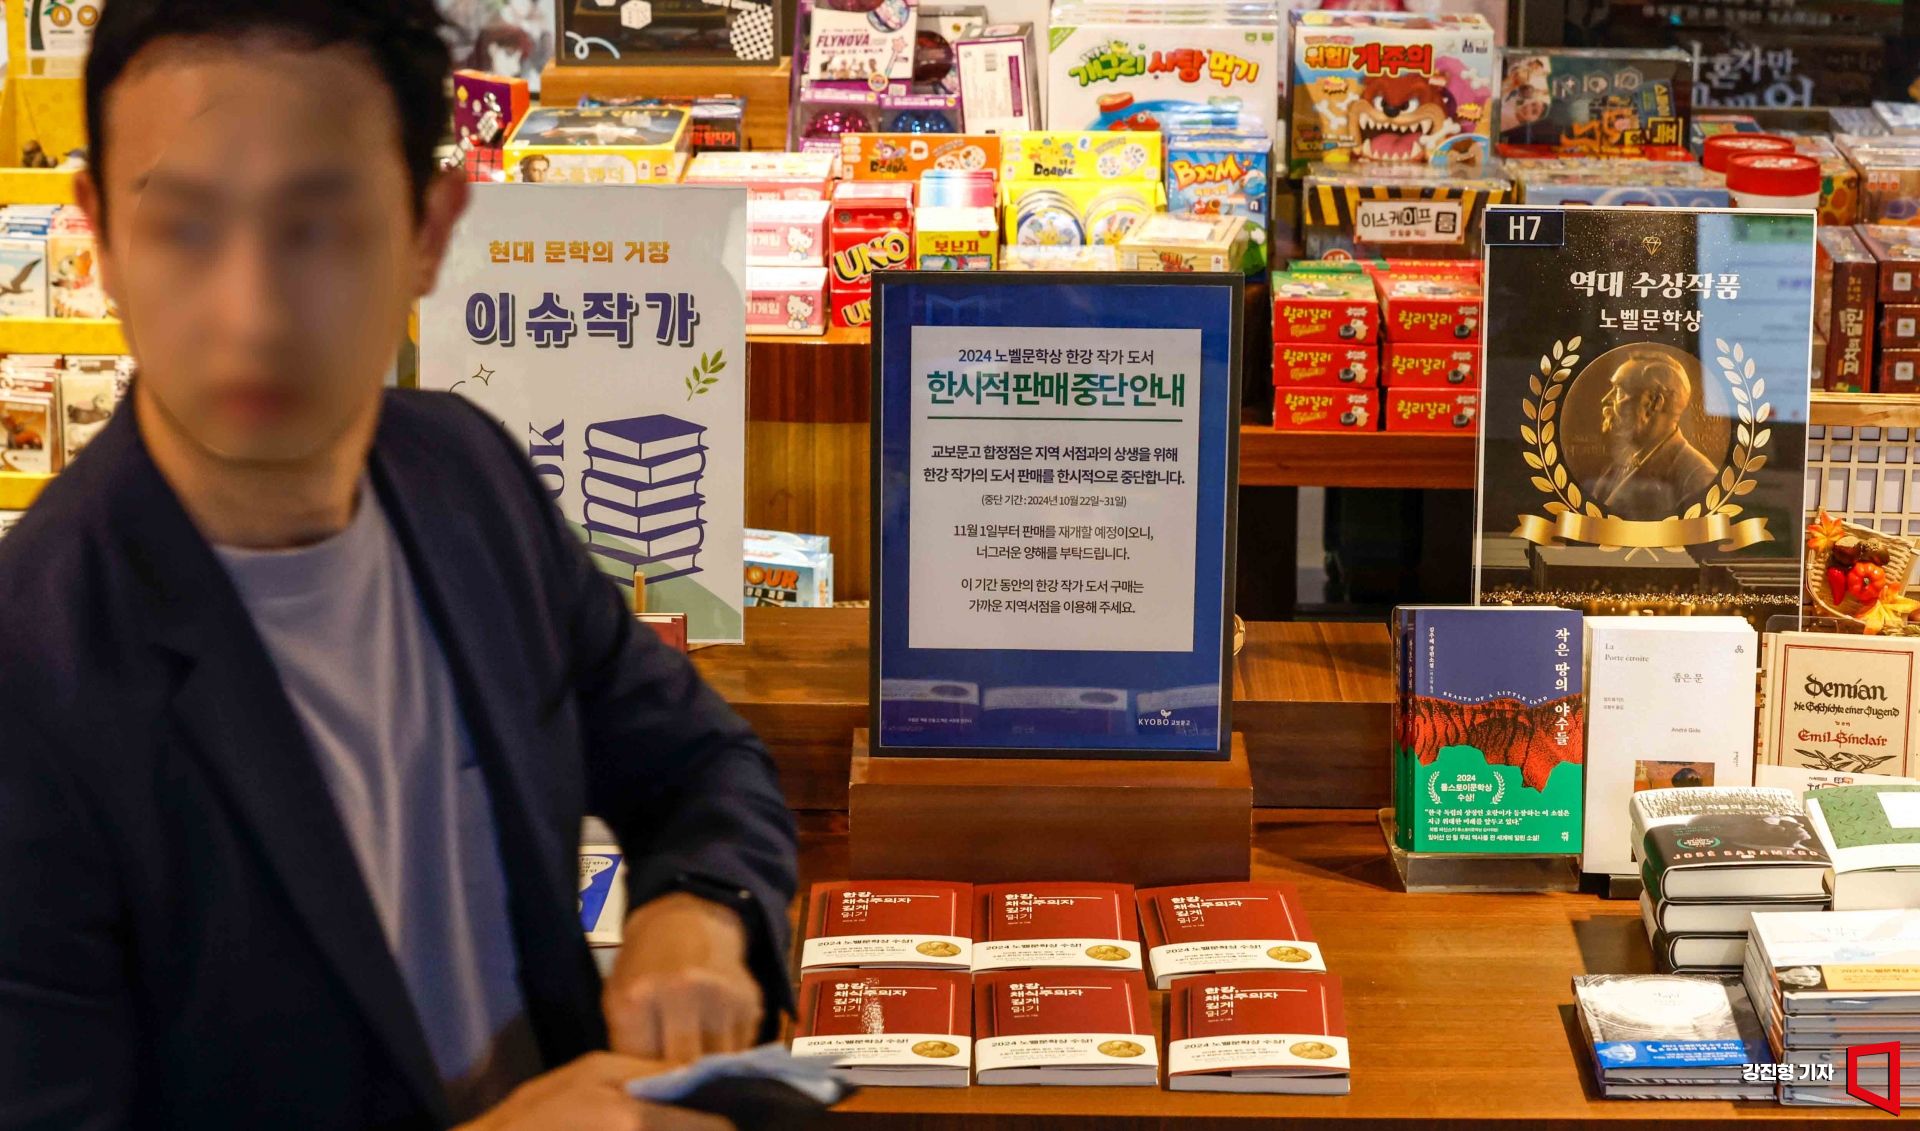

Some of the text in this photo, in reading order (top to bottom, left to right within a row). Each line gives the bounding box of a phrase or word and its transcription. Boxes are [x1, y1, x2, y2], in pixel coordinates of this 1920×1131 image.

[816, 34, 869, 47] FLYNOVA
[1305, 42, 1433, 75] 위험! 개주의
[1069, 49, 1259, 86] 개구리 사탕 먹기
[1170, 153, 1242, 191] BOOM
[1361, 206, 1432, 227] 이스케이프
[1509, 215, 1542, 240] H7
[489, 240, 670, 264] 현대 문학의 거장
[935, 240, 979, 253] 보난자
[833, 231, 910, 283] UNO
[1570, 271, 1741, 299] 역대 수상작품
[465, 292, 700, 348] 이슈작가
[1599, 309, 1704, 332] 노벨문학상
[958, 349, 1154, 365] 2024 노벨문학상 한강 작가 도서
[927, 371, 1185, 407] 한시적 판매 중단 안내
[931, 446, 1178, 463] 교보문고 합정점은 지역 서점과의 상생을 위해
[923, 468, 1185, 486] 한강 작가의 도서 판매를 한시적으로 중단합니다.
[981, 495, 1003, 507] (중단
[1060, 496, 1079, 506] 10월
[1080, 496, 1127, 507] 22일~31일)
[953, 525, 1154, 541] 11월 1일부터 판매를 재개할 예정이오니,
[976, 547, 1130, 560] 너그러운 양해를 부탁드립니다.
[745, 566, 799, 590] OUR
[961, 578, 1144, 593] 이 기간 동안의 한강 작가 도서 구매는
[969, 599, 1002, 612] 가까운
[1063, 600, 1097, 613] 이용해
[1099, 601, 1136, 614] 주세요.
[1673, 673, 1704, 683] 좁은 문
[1554, 628, 1571, 746] 작은 땅의 야수들
[1804, 674, 1888, 701] Demian
[1443, 691, 1472, 702] BEASTS
[1497, 691, 1526, 701] LITTLE
[1529, 696, 1548, 705] LAND
[1794, 701, 1899, 719] Die Geschichte einer Jugend
[1138, 718, 1169, 726] KYOBO
[1798, 728, 1888, 749] Emil Sinclair
[1457, 774, 1476, 782] 2024
[1457, 793, 1475, 802] 수상!
[1173, 900, 1243, 909] 채식주의자
[1177, 916, 1204, 924] 읽기
[834, 989, 908, 997] 채식주의자
[1009, 989, 1083, 998] 채식주의자
[1205, 992, 1278, 1000] 채식주의자
[832, 1005, 861, 1013] 읽기
[1010, 1005, 1039, 1013] 읽기
[1205, 1009, 1234, 1017] 읽기
